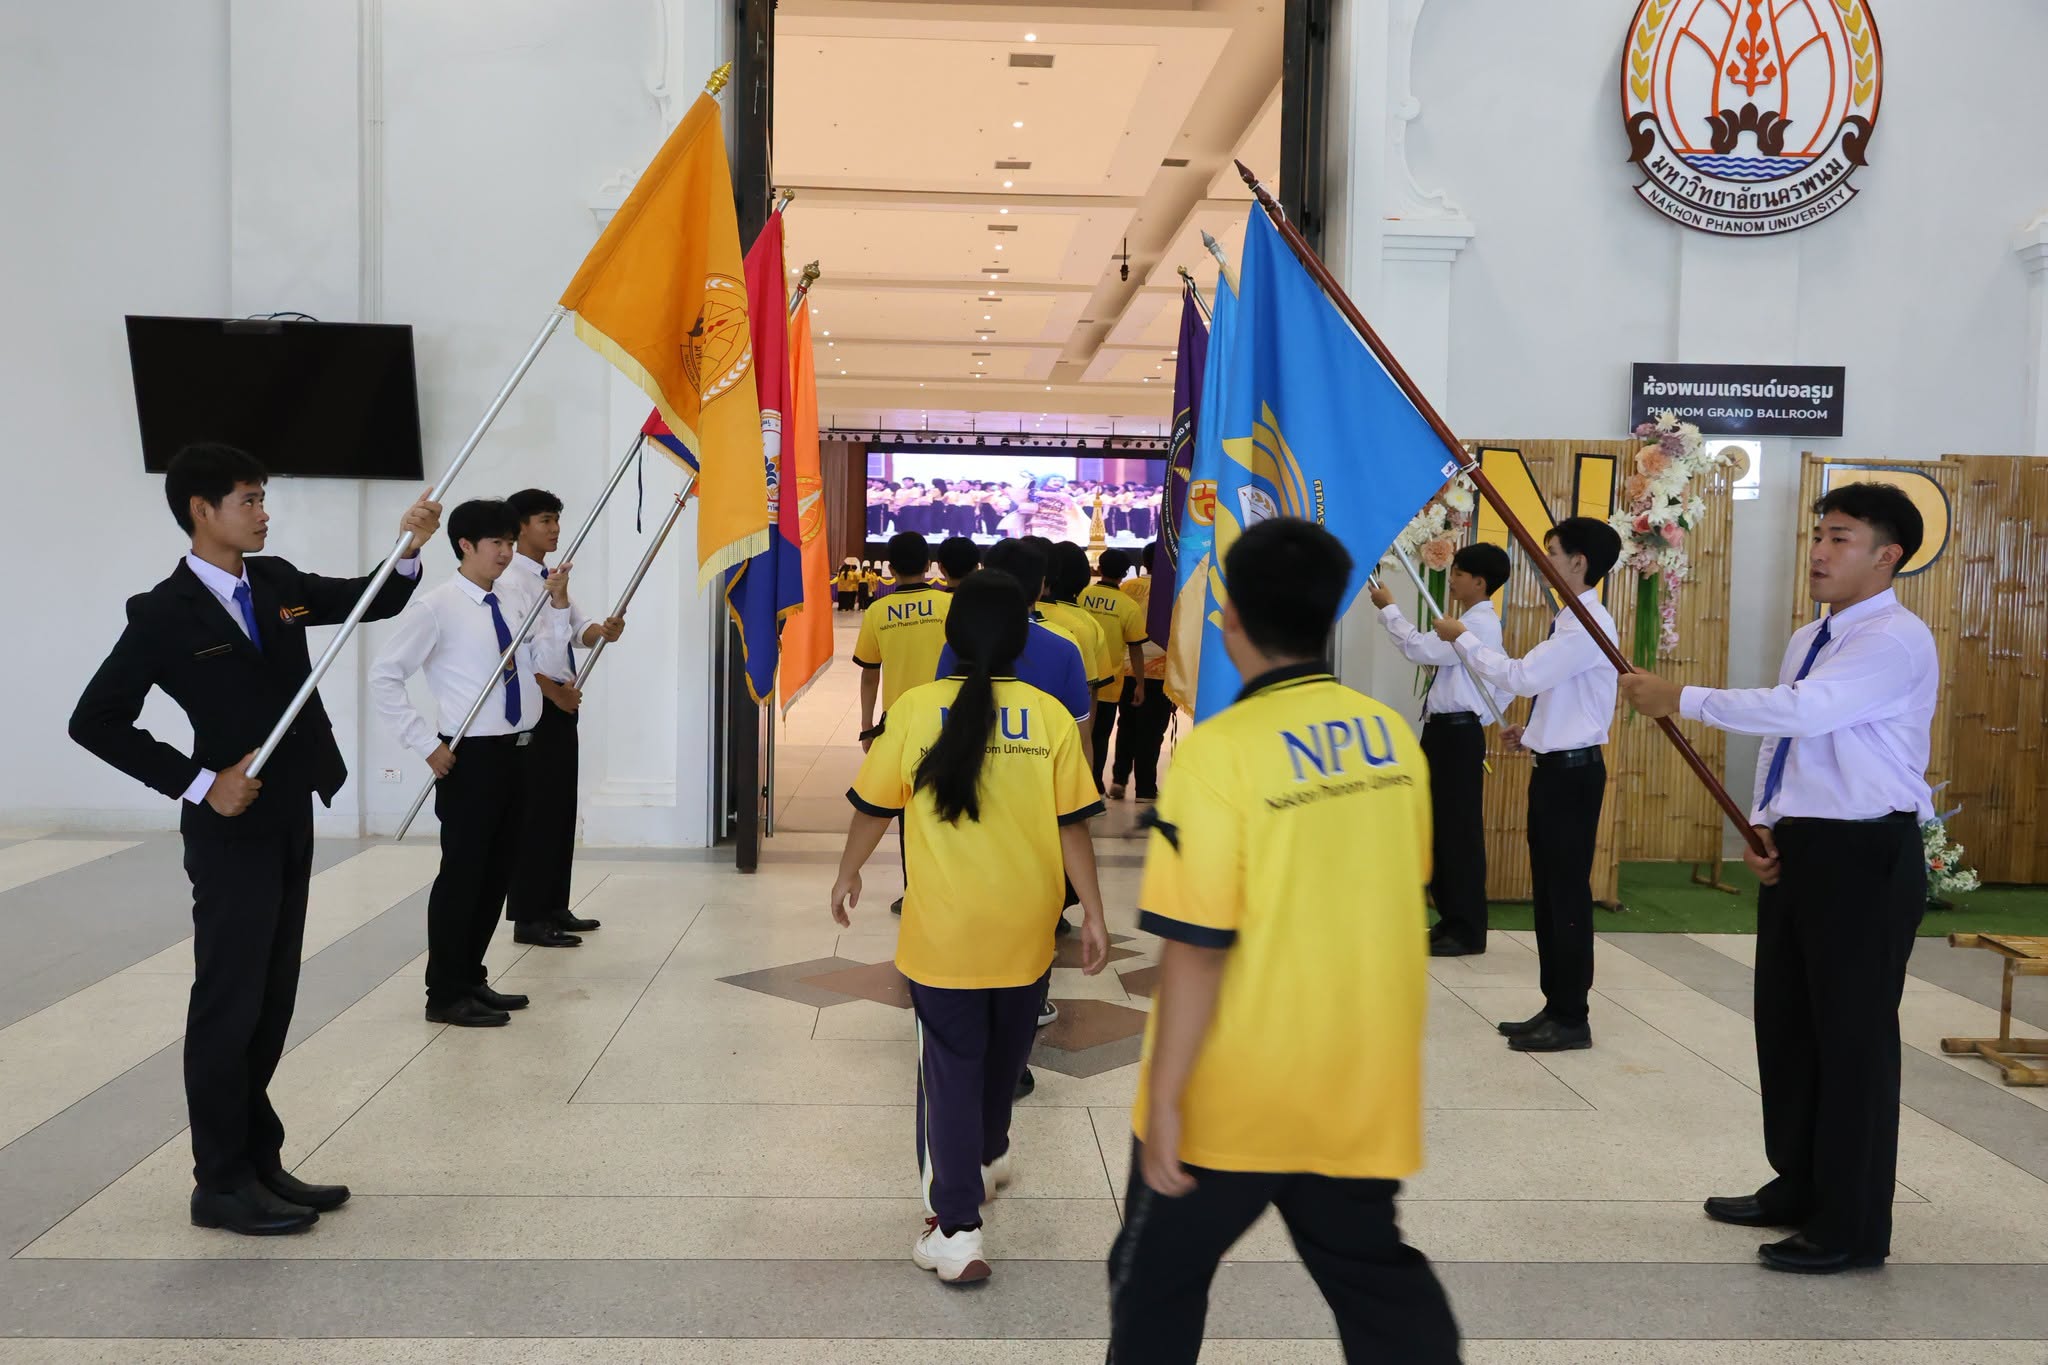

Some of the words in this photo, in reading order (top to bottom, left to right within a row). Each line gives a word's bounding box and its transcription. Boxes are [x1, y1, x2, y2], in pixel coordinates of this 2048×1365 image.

[1651, 155, 1845, 210] มหาวิทยาลัยนครพนม
[1648, 189, 1702, 225] NAKHON
[1706, 217, 1765, 232] PHANOM
[1768, 189, 1845, 231] UNIVERSITY
[1643, 375, 1834, 405] ห้องพนมแกรนด์บอลรูม
[1707, 407, 1754, 418] GRAND
[1756, 408, 1828, 419] BALLROOM
[887, 599, 934, 622] NPU
[1083, 595, 1117, 612] NPU
[1003, 743, 1051, 759] University
[1277, 714, 1399, 783] NPU
